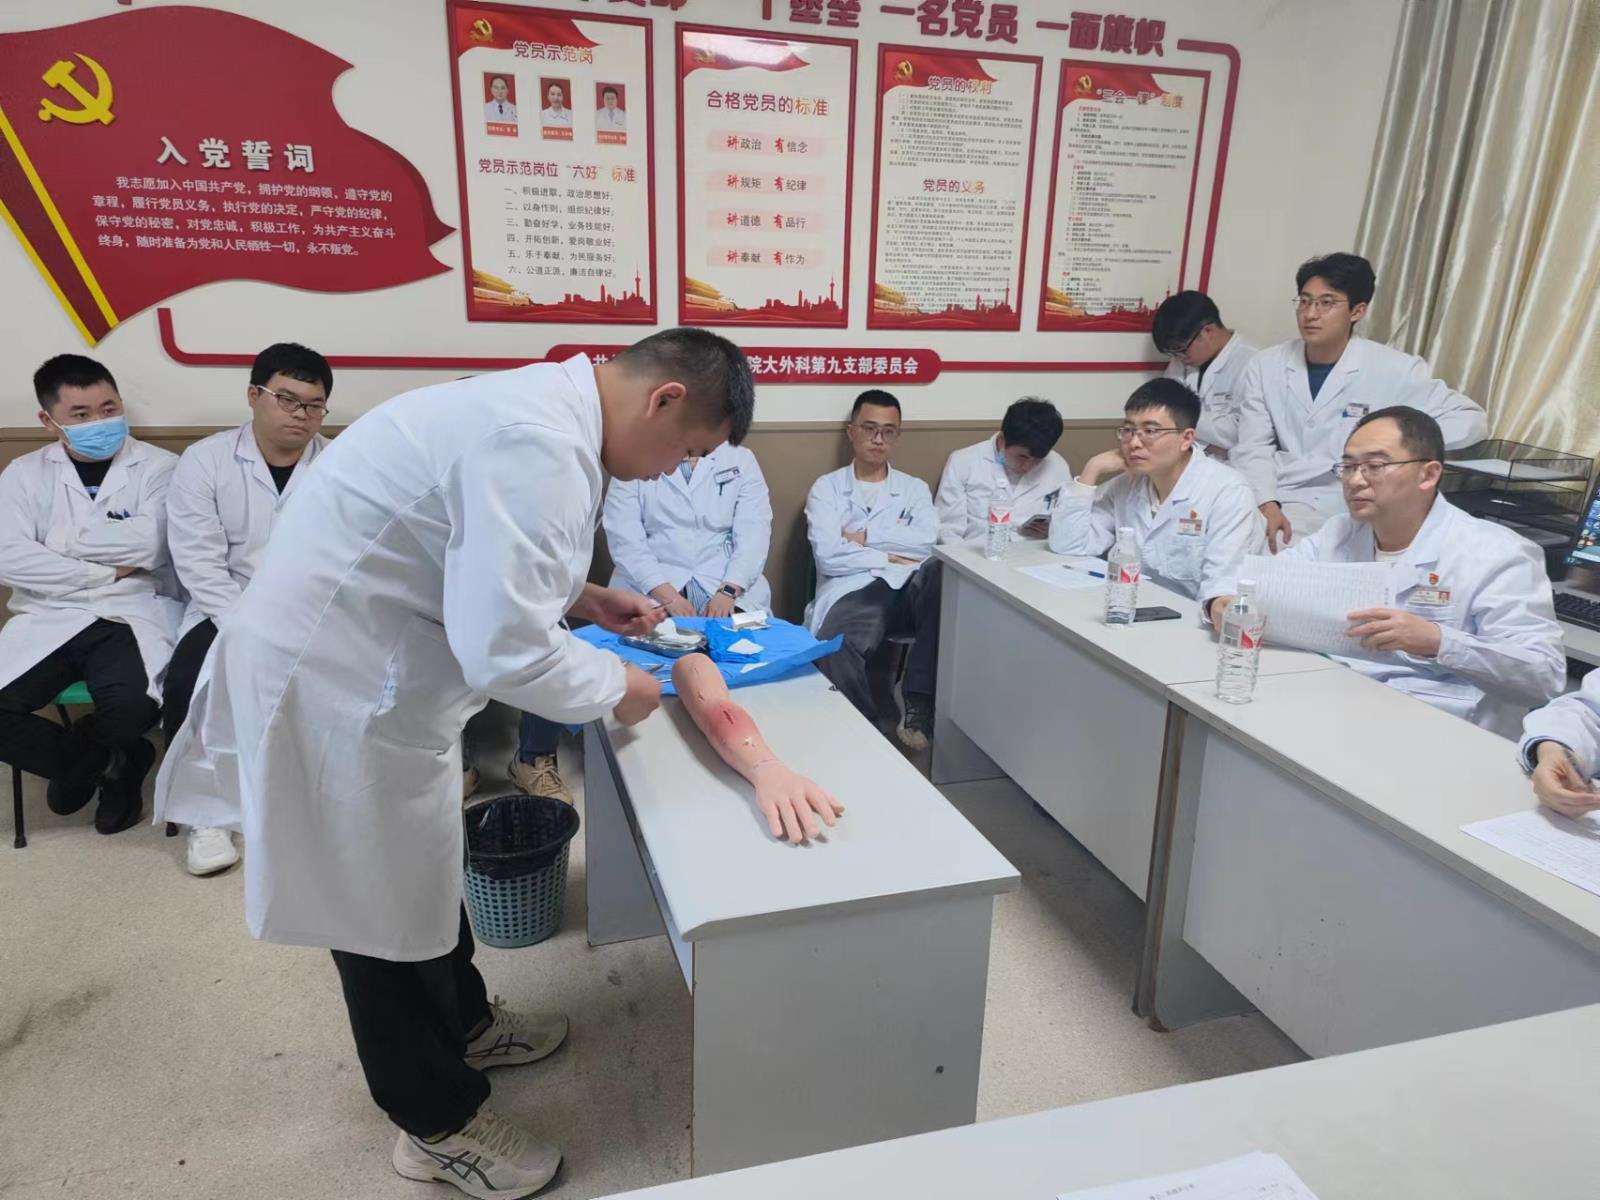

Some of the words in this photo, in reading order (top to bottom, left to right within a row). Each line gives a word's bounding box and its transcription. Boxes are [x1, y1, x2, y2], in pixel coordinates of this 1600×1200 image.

[880, 0, 1018, 44] 一名党员
[1036, 11, 1166, 57] 一面旗帜
[513, 40, 594, 65] 党员示范岗
[927, 75, 994, 95] 党员的权利
[706, 90, 829, 116] 合格党员的标准
[726, 135, 762, 151] 讲政治
[774, 137, 809, 153] 有信念
[156, 135, 315, 174] 入党誓词
[726, 174, 762, 190] 讲规矩
[774, 175, 807, 192] 有纪律
[922, 178, 986, 194] 党员的义务
[726, 212, 762, 228] 讲道德
[773, 213, 806, 229] 有品行
[726, 250, 761, 264] 讲奉献
[773, 251, 805, 266] 有作为
